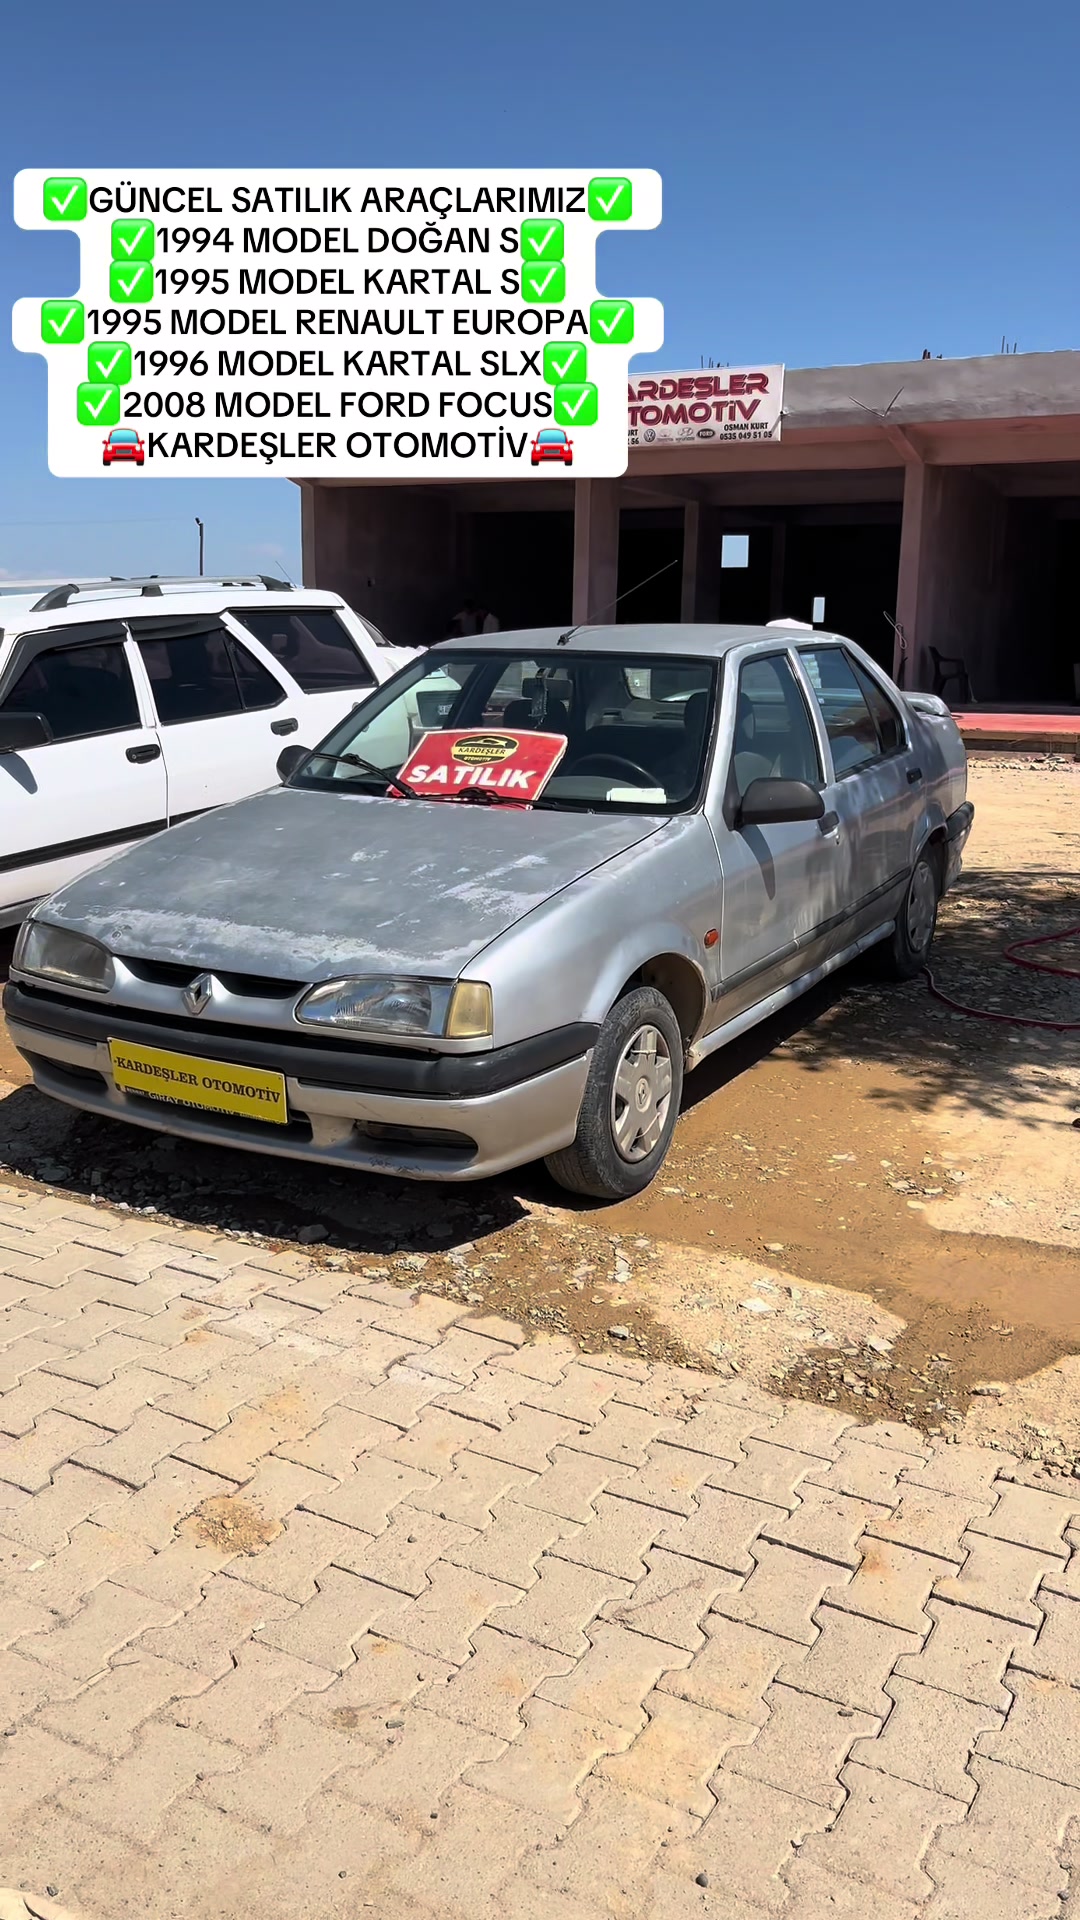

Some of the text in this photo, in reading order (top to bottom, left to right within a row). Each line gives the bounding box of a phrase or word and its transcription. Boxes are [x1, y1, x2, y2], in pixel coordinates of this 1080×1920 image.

[628, 373, 769, 402] ARDEŞLER
[628, 399, 762, 427] TOMOTİV
[719, 432, 737, 440] 0535
[738, 432, 751, 440] 049
[753, 431, 761, 439] 51
[724, 422, 768, 431] OSMAN KURT
[458, 747, 506, 755] KARDEŞLER
[406, 765, 537, 789] SATILIK
[116, 1057, 281, 1103] KARDEŞLER OTOMOTİV
